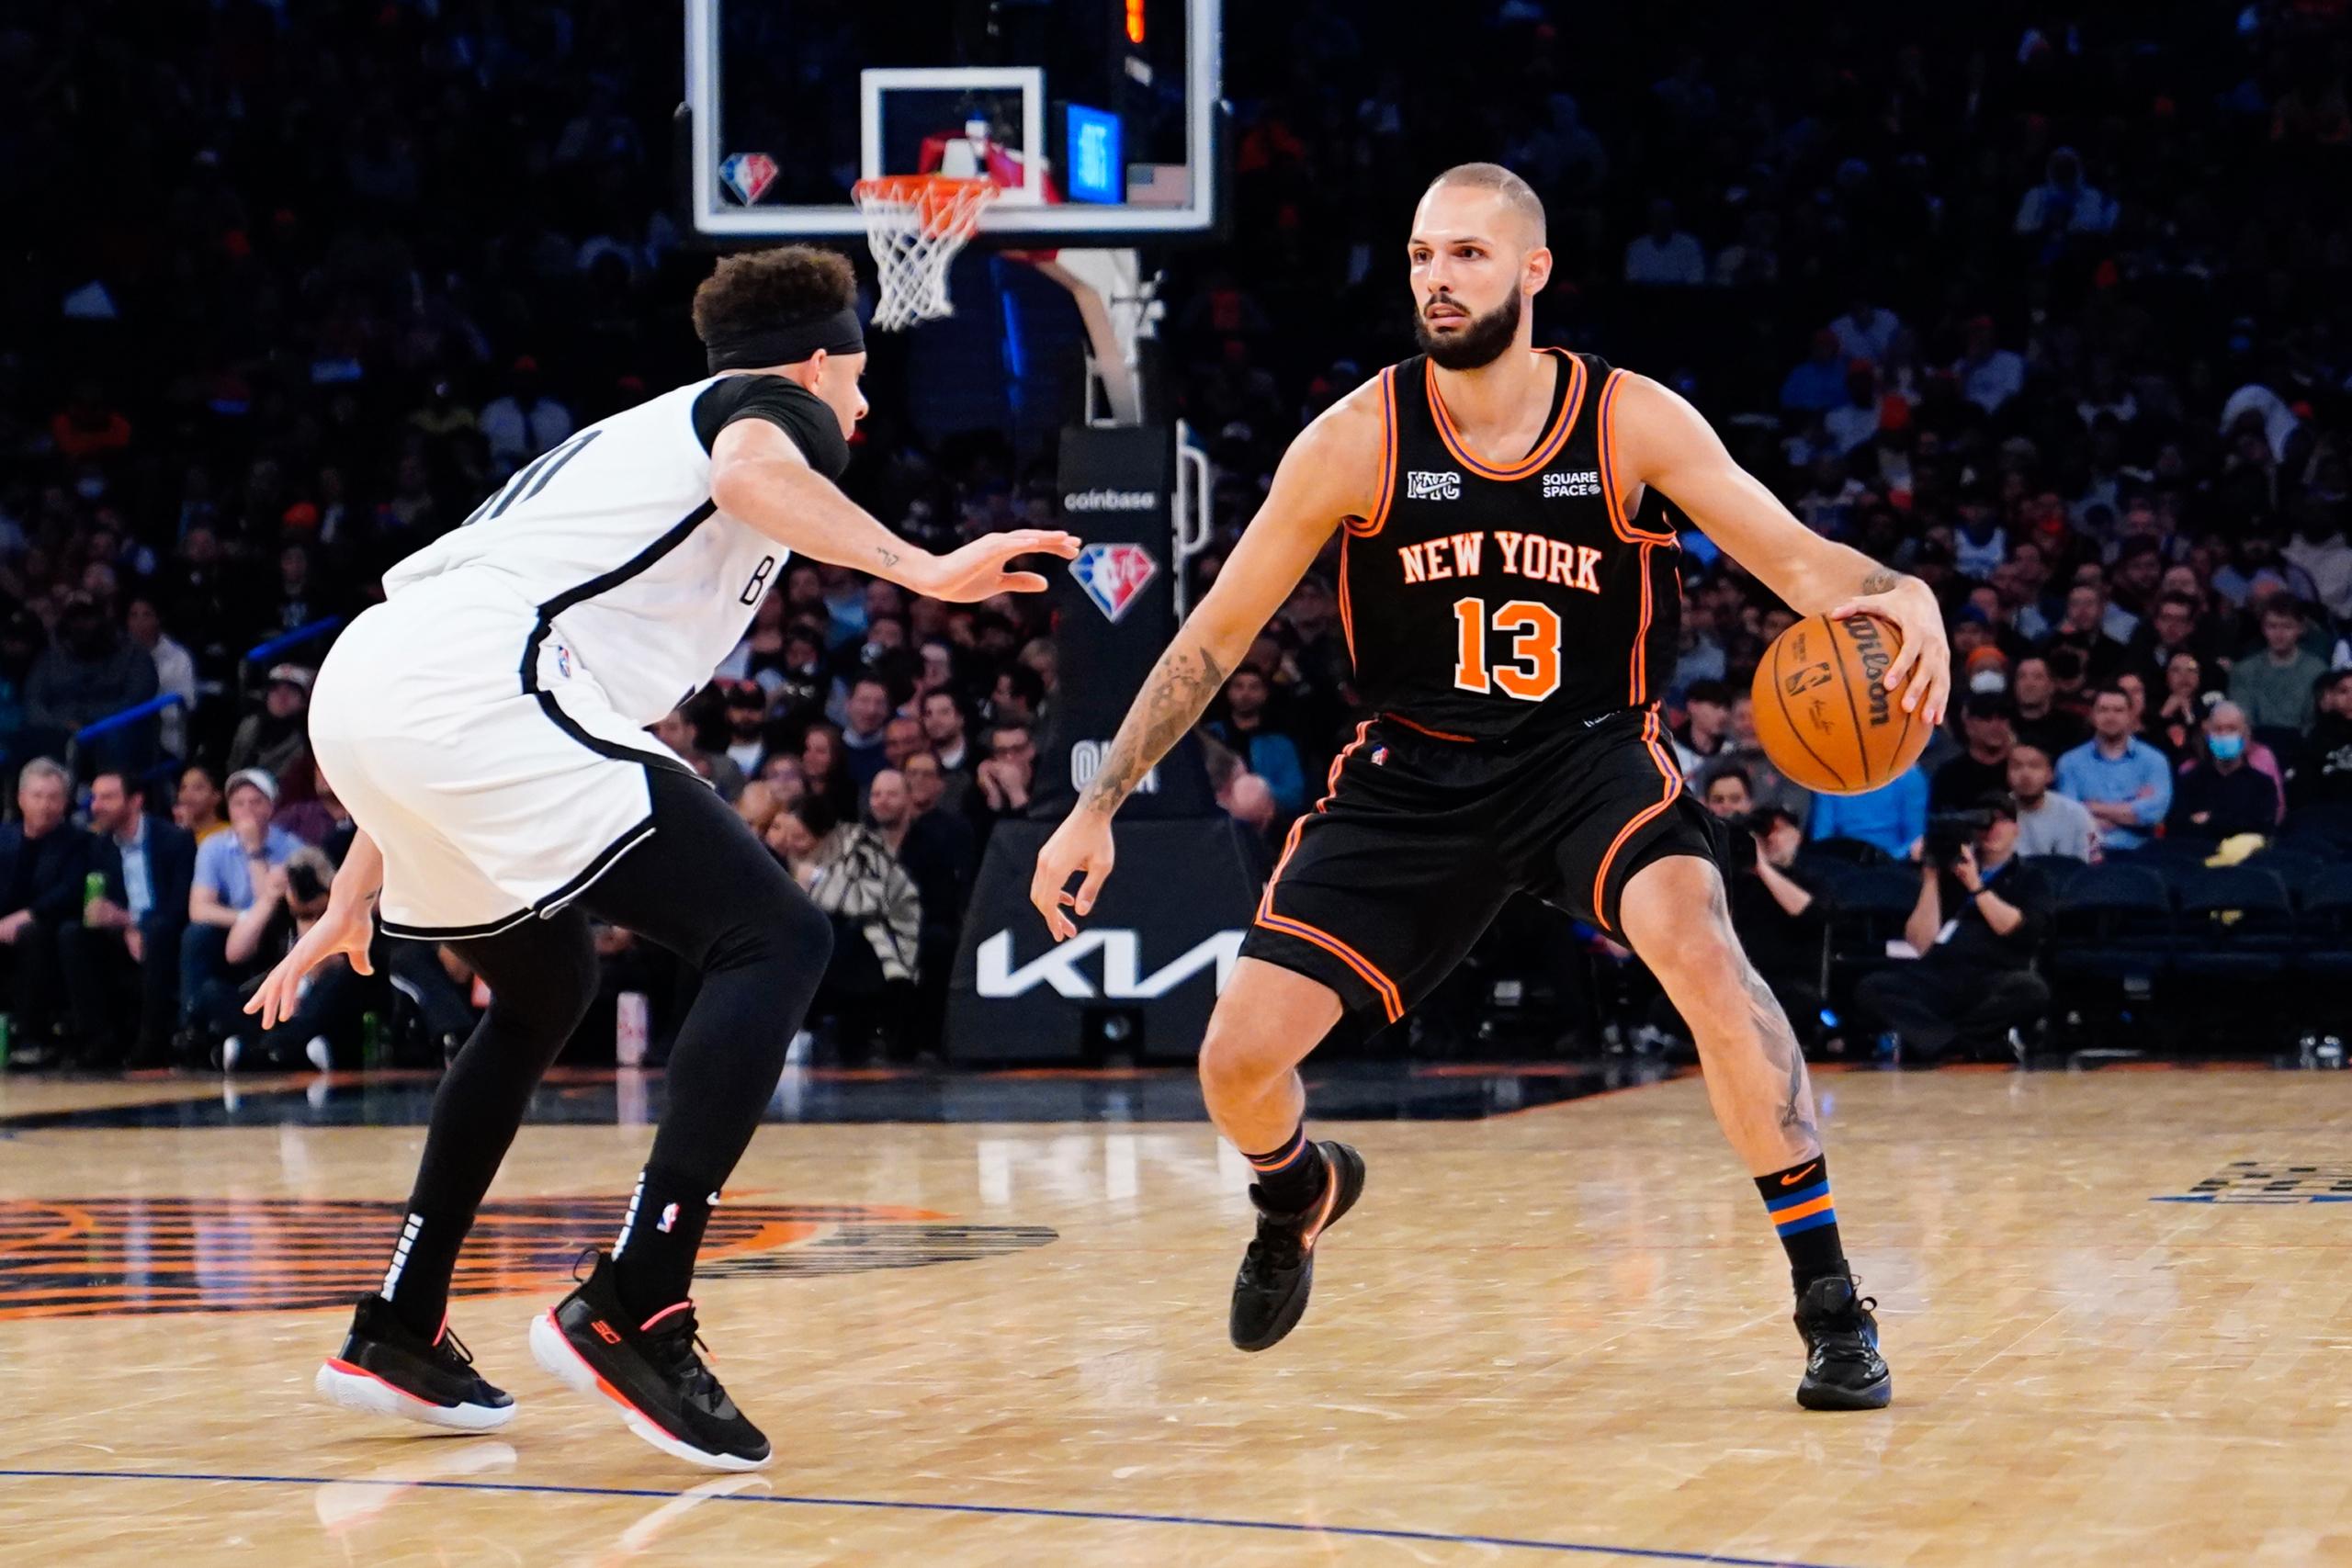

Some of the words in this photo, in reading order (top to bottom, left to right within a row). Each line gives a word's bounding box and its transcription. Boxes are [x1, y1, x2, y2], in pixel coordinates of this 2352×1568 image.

[1408, 471, 1461, 501] NYC
[1543, 471, 1599, 486] SQUARE
[1543, 484, 1588, 498] SPACE
[1064, 489, 1155, 511] coinbase
[1397, 531, 1485, 585] NEW
[1493, 530, 1602, 595] YORK
[1453, 596, 1562, 702] 13
[1842, 615, 1891, 726] Wilson
